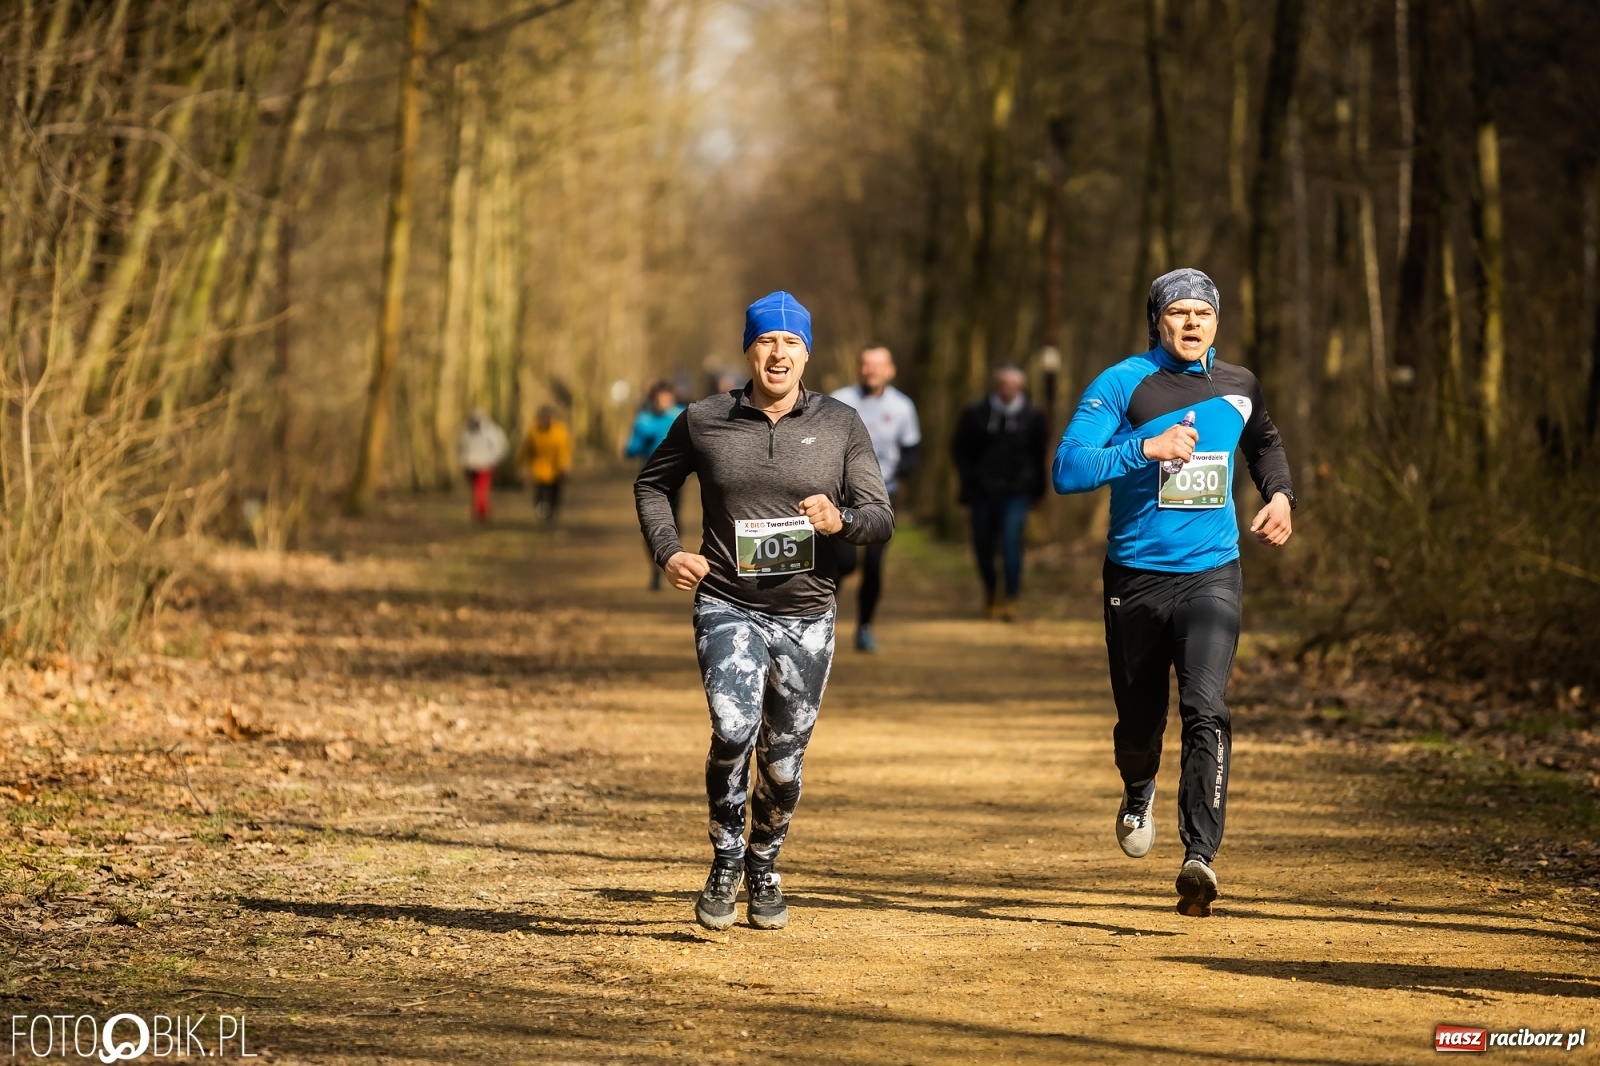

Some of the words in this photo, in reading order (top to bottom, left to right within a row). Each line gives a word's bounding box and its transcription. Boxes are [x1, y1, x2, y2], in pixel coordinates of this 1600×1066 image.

[800, 436, 817, 445] 4F
[1175, 470, 1219, 492] 030
[750, 521, 766, 529] BIEG
[766, 519, 805, 528] Twardziela
[753, 537, 798, 560] 105
[1215, 764, 1224, 786] THE
[1212, 785, 1222, 809] LINE
